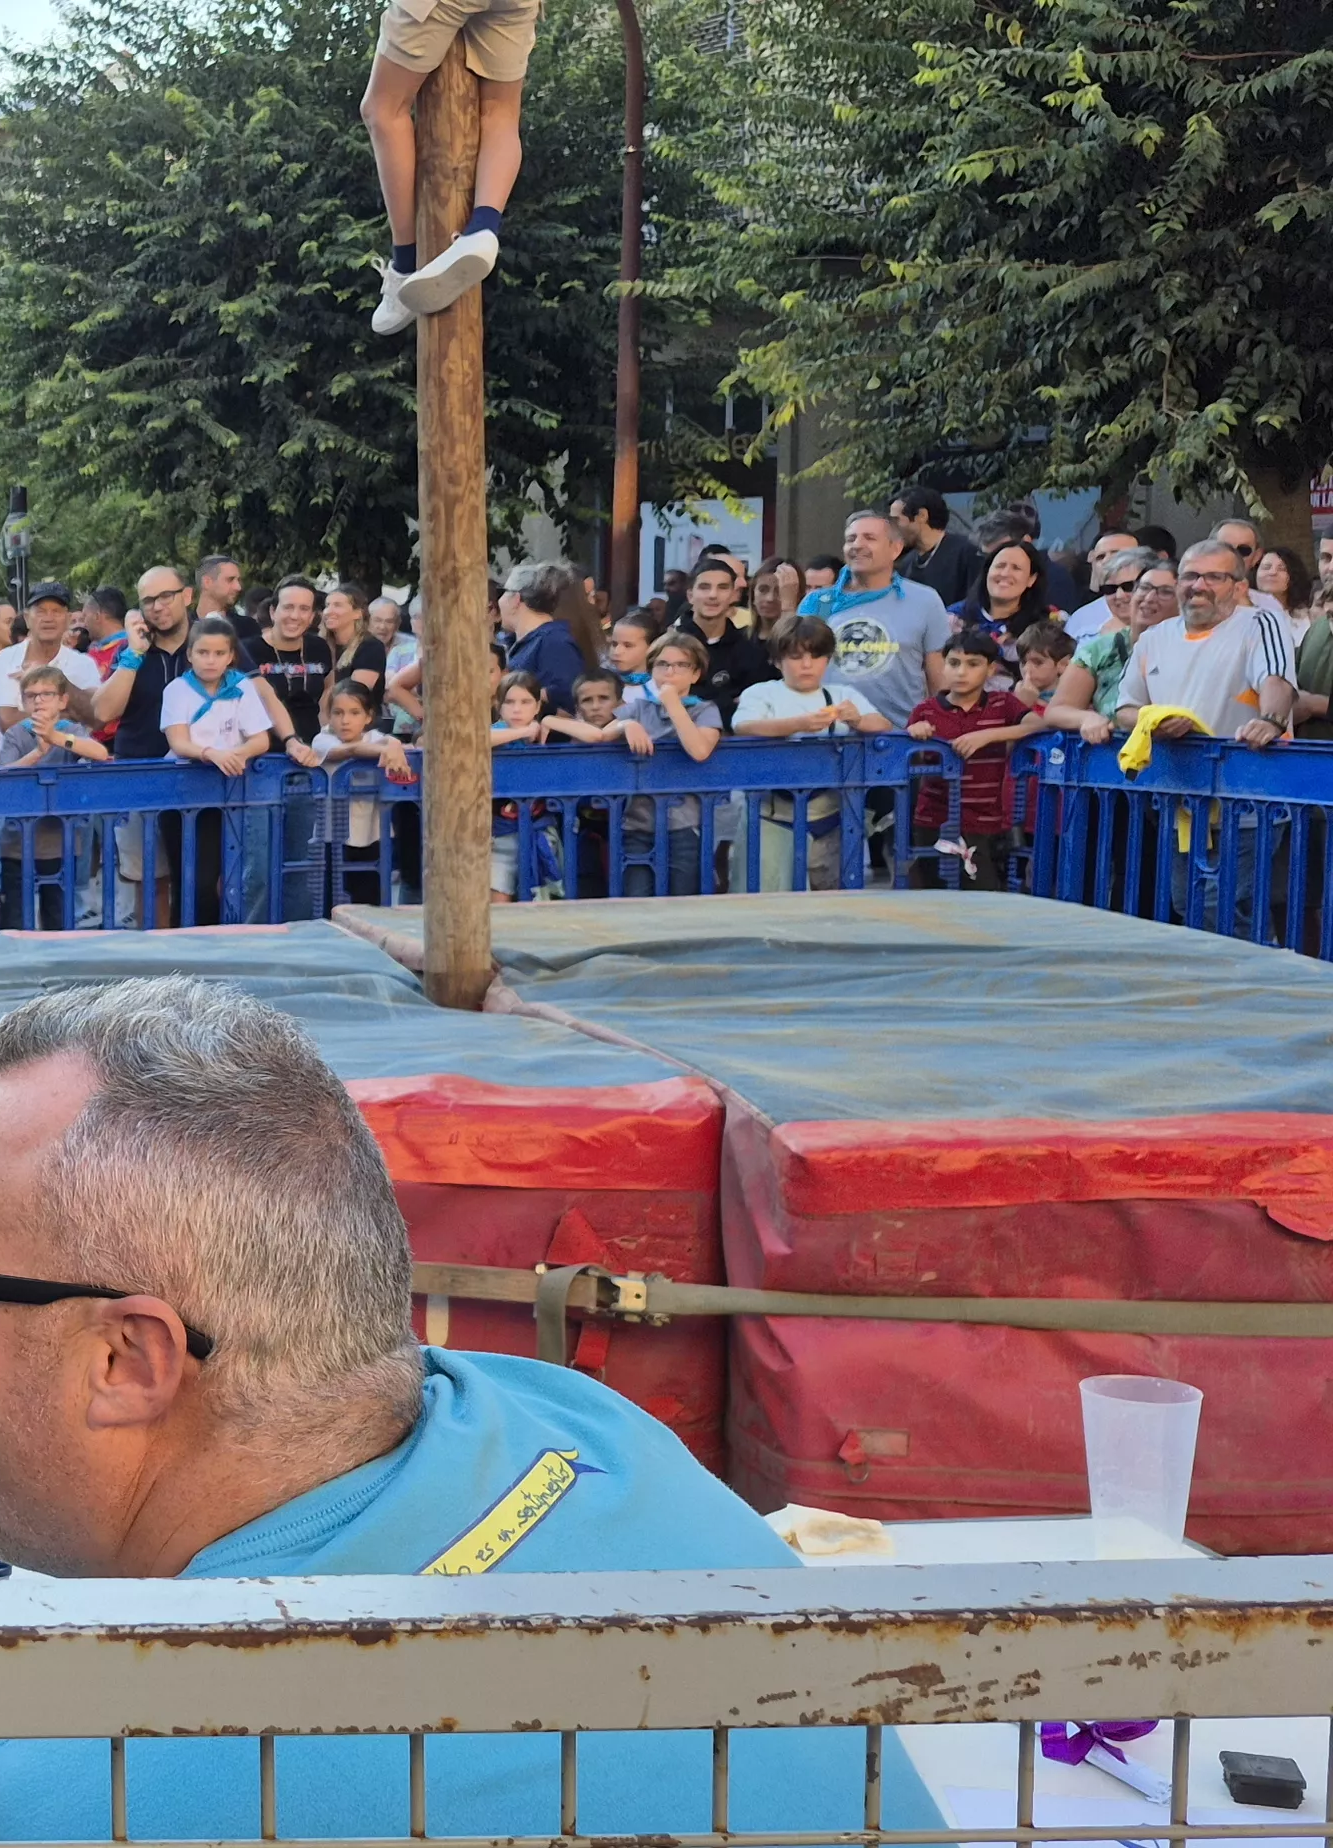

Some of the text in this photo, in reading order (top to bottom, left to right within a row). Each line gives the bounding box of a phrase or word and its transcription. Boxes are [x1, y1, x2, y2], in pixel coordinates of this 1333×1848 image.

[475, 1542, 495, 1562] es
[497, 1527, 516, 1543] un
[518, 1462, 570, 1528] sentimiento
